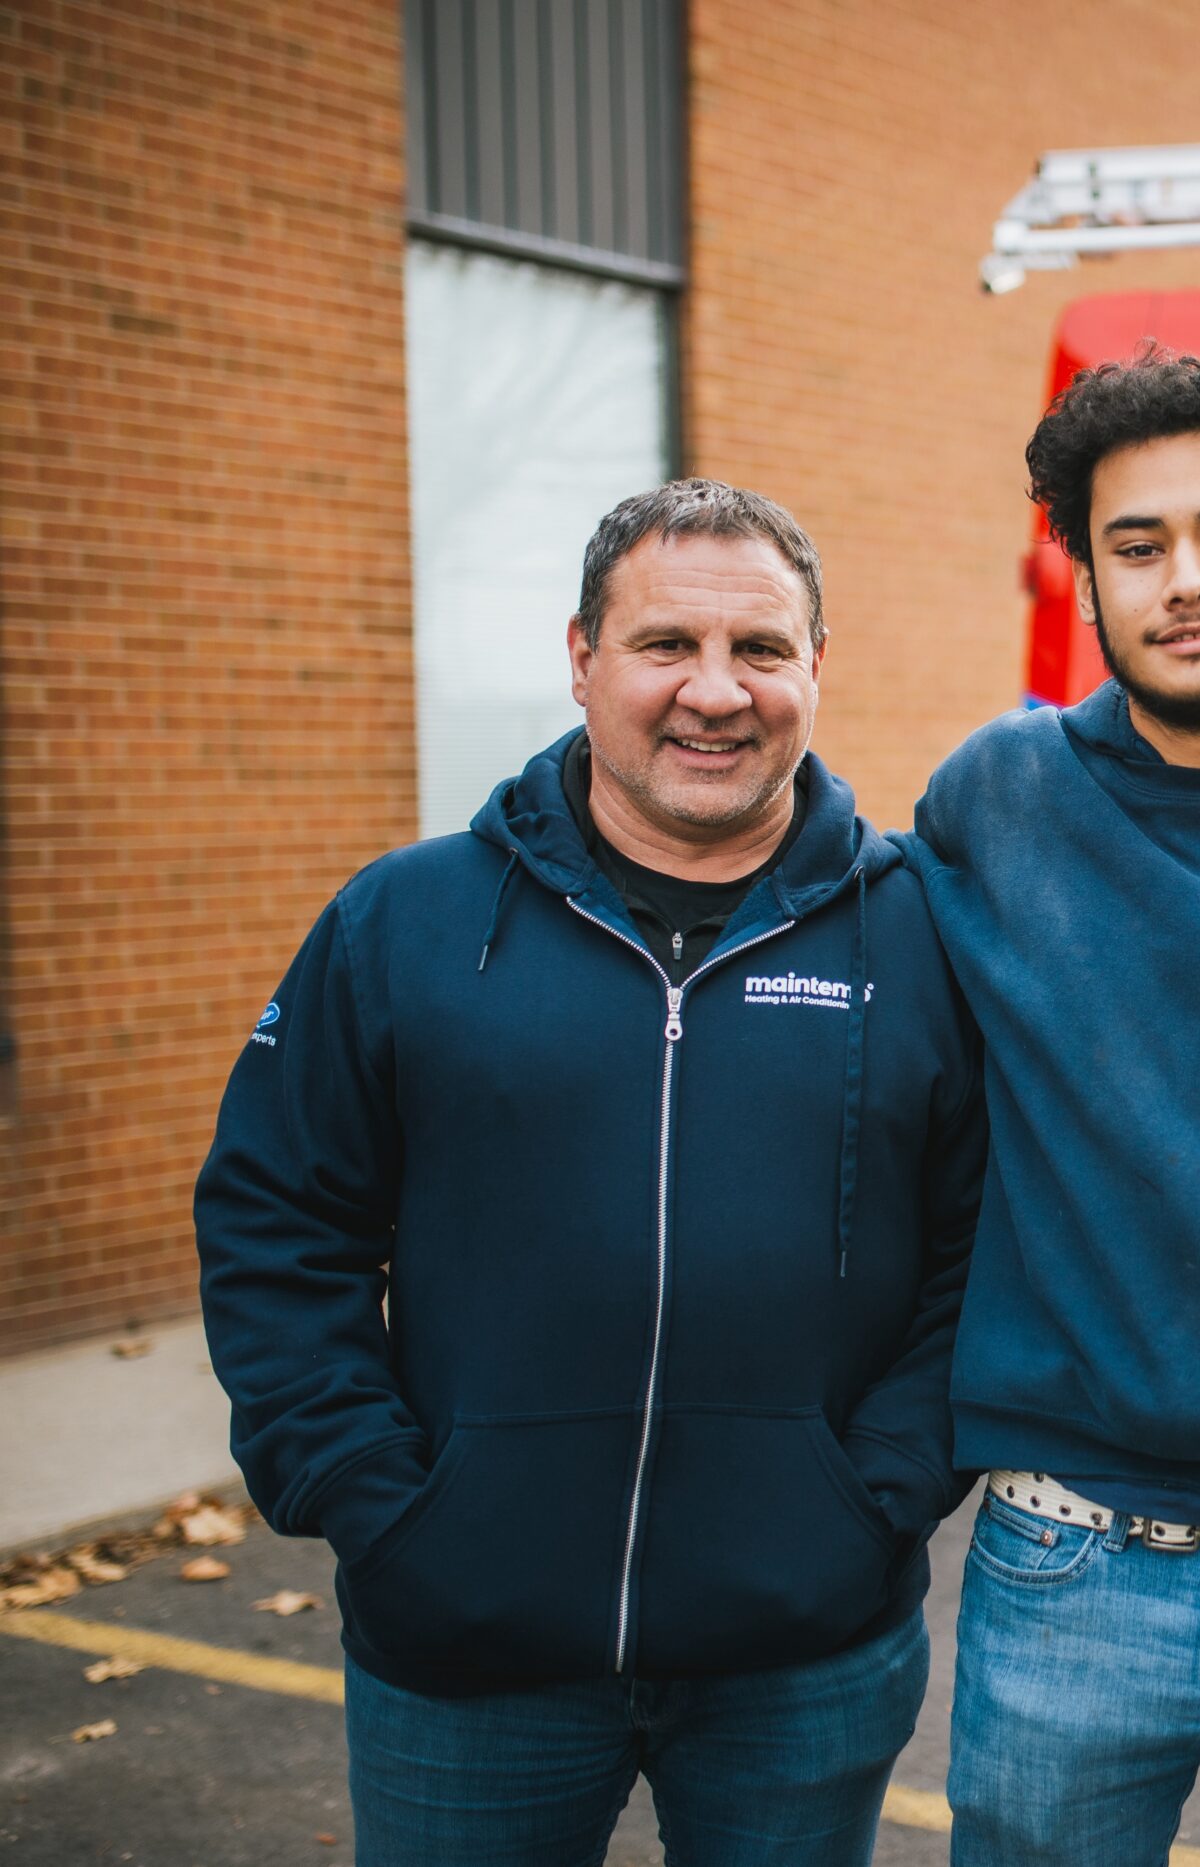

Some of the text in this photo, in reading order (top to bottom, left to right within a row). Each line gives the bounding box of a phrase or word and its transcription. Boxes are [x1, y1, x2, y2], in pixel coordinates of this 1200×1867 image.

[744, 994, 850, 1010] Heating & Air Conditionin
